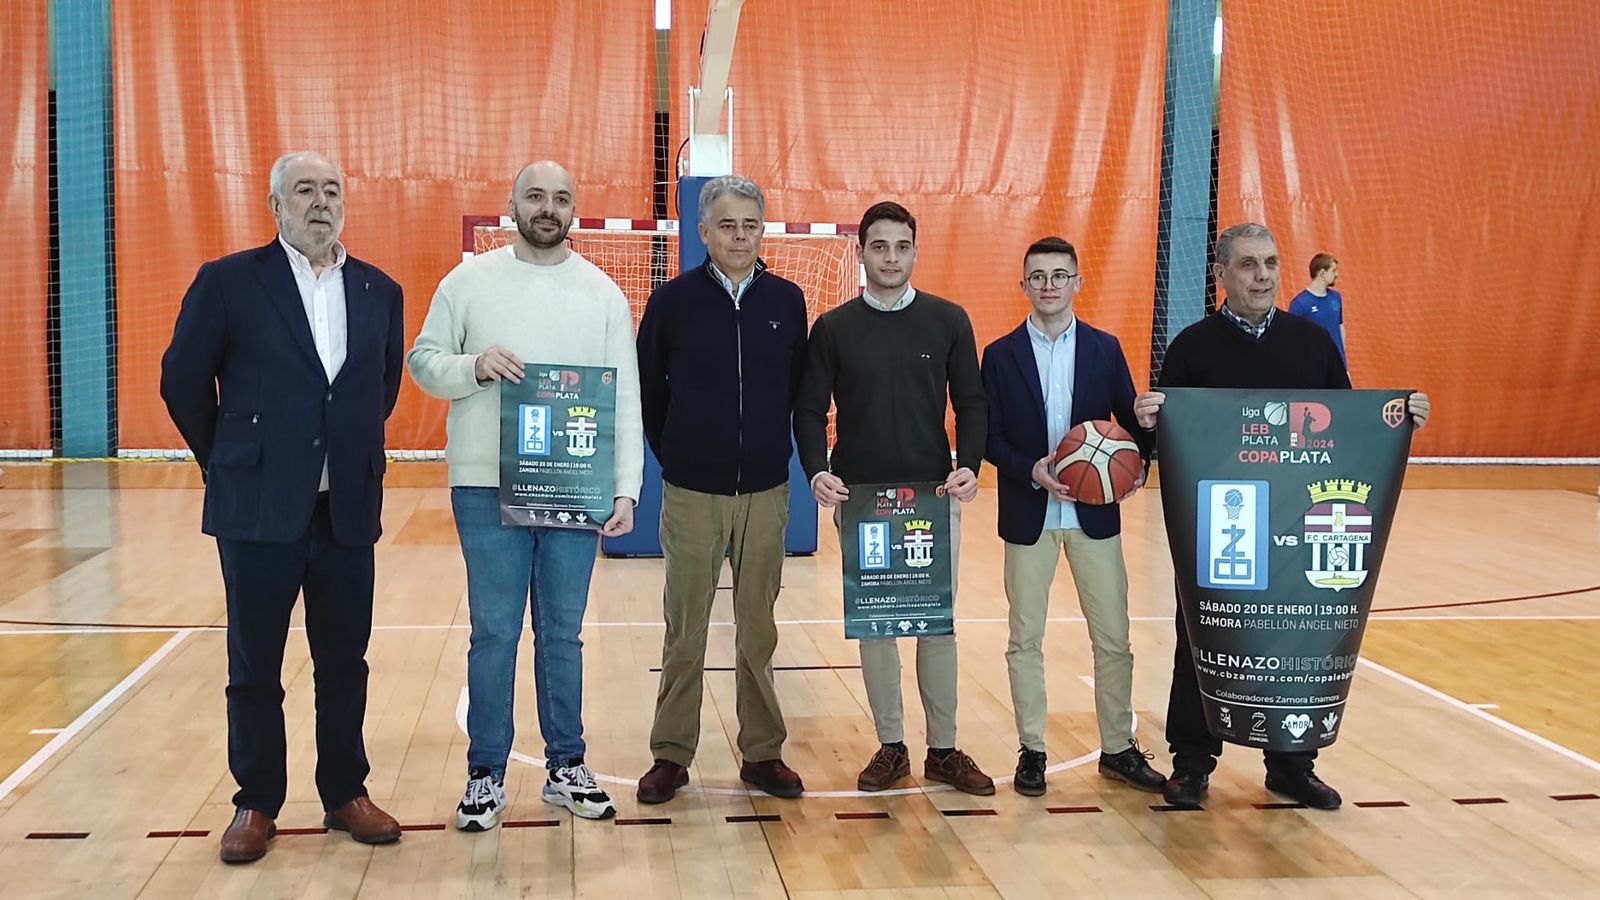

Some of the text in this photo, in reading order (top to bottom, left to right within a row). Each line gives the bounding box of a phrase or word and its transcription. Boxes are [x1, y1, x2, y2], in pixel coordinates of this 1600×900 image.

[1242, 407, 1260, 419] Liga
[1242, 423, 1269, 434] LEB
[1242, 435, 1279, 446] PLATA
[1290, 432, 1298, 447] FEB
[1306, 440, 1334, 449] 2024
[1307, 534, 1370, 542] F.C. CARTAGENA
[1199, 600, 1241, 614] SÁBADO
[1243, 604, 1258, 614] 20
[1262, 604, 1274, 615] DE
[1277, 604, 1312, 615] ENERO
[1320, 604, 1348, 616] 19:00
[1350, 604, 1359, 614] H.
[1200, 615, 1359, 630] ZAMORA PABELLÓN ÁNGEL NIETO
[1197, 664, 1353, 684] www.cbzamora.com/copalebp
[1215, 689, 1340, 704] Colaboradores Zamora Enamora
